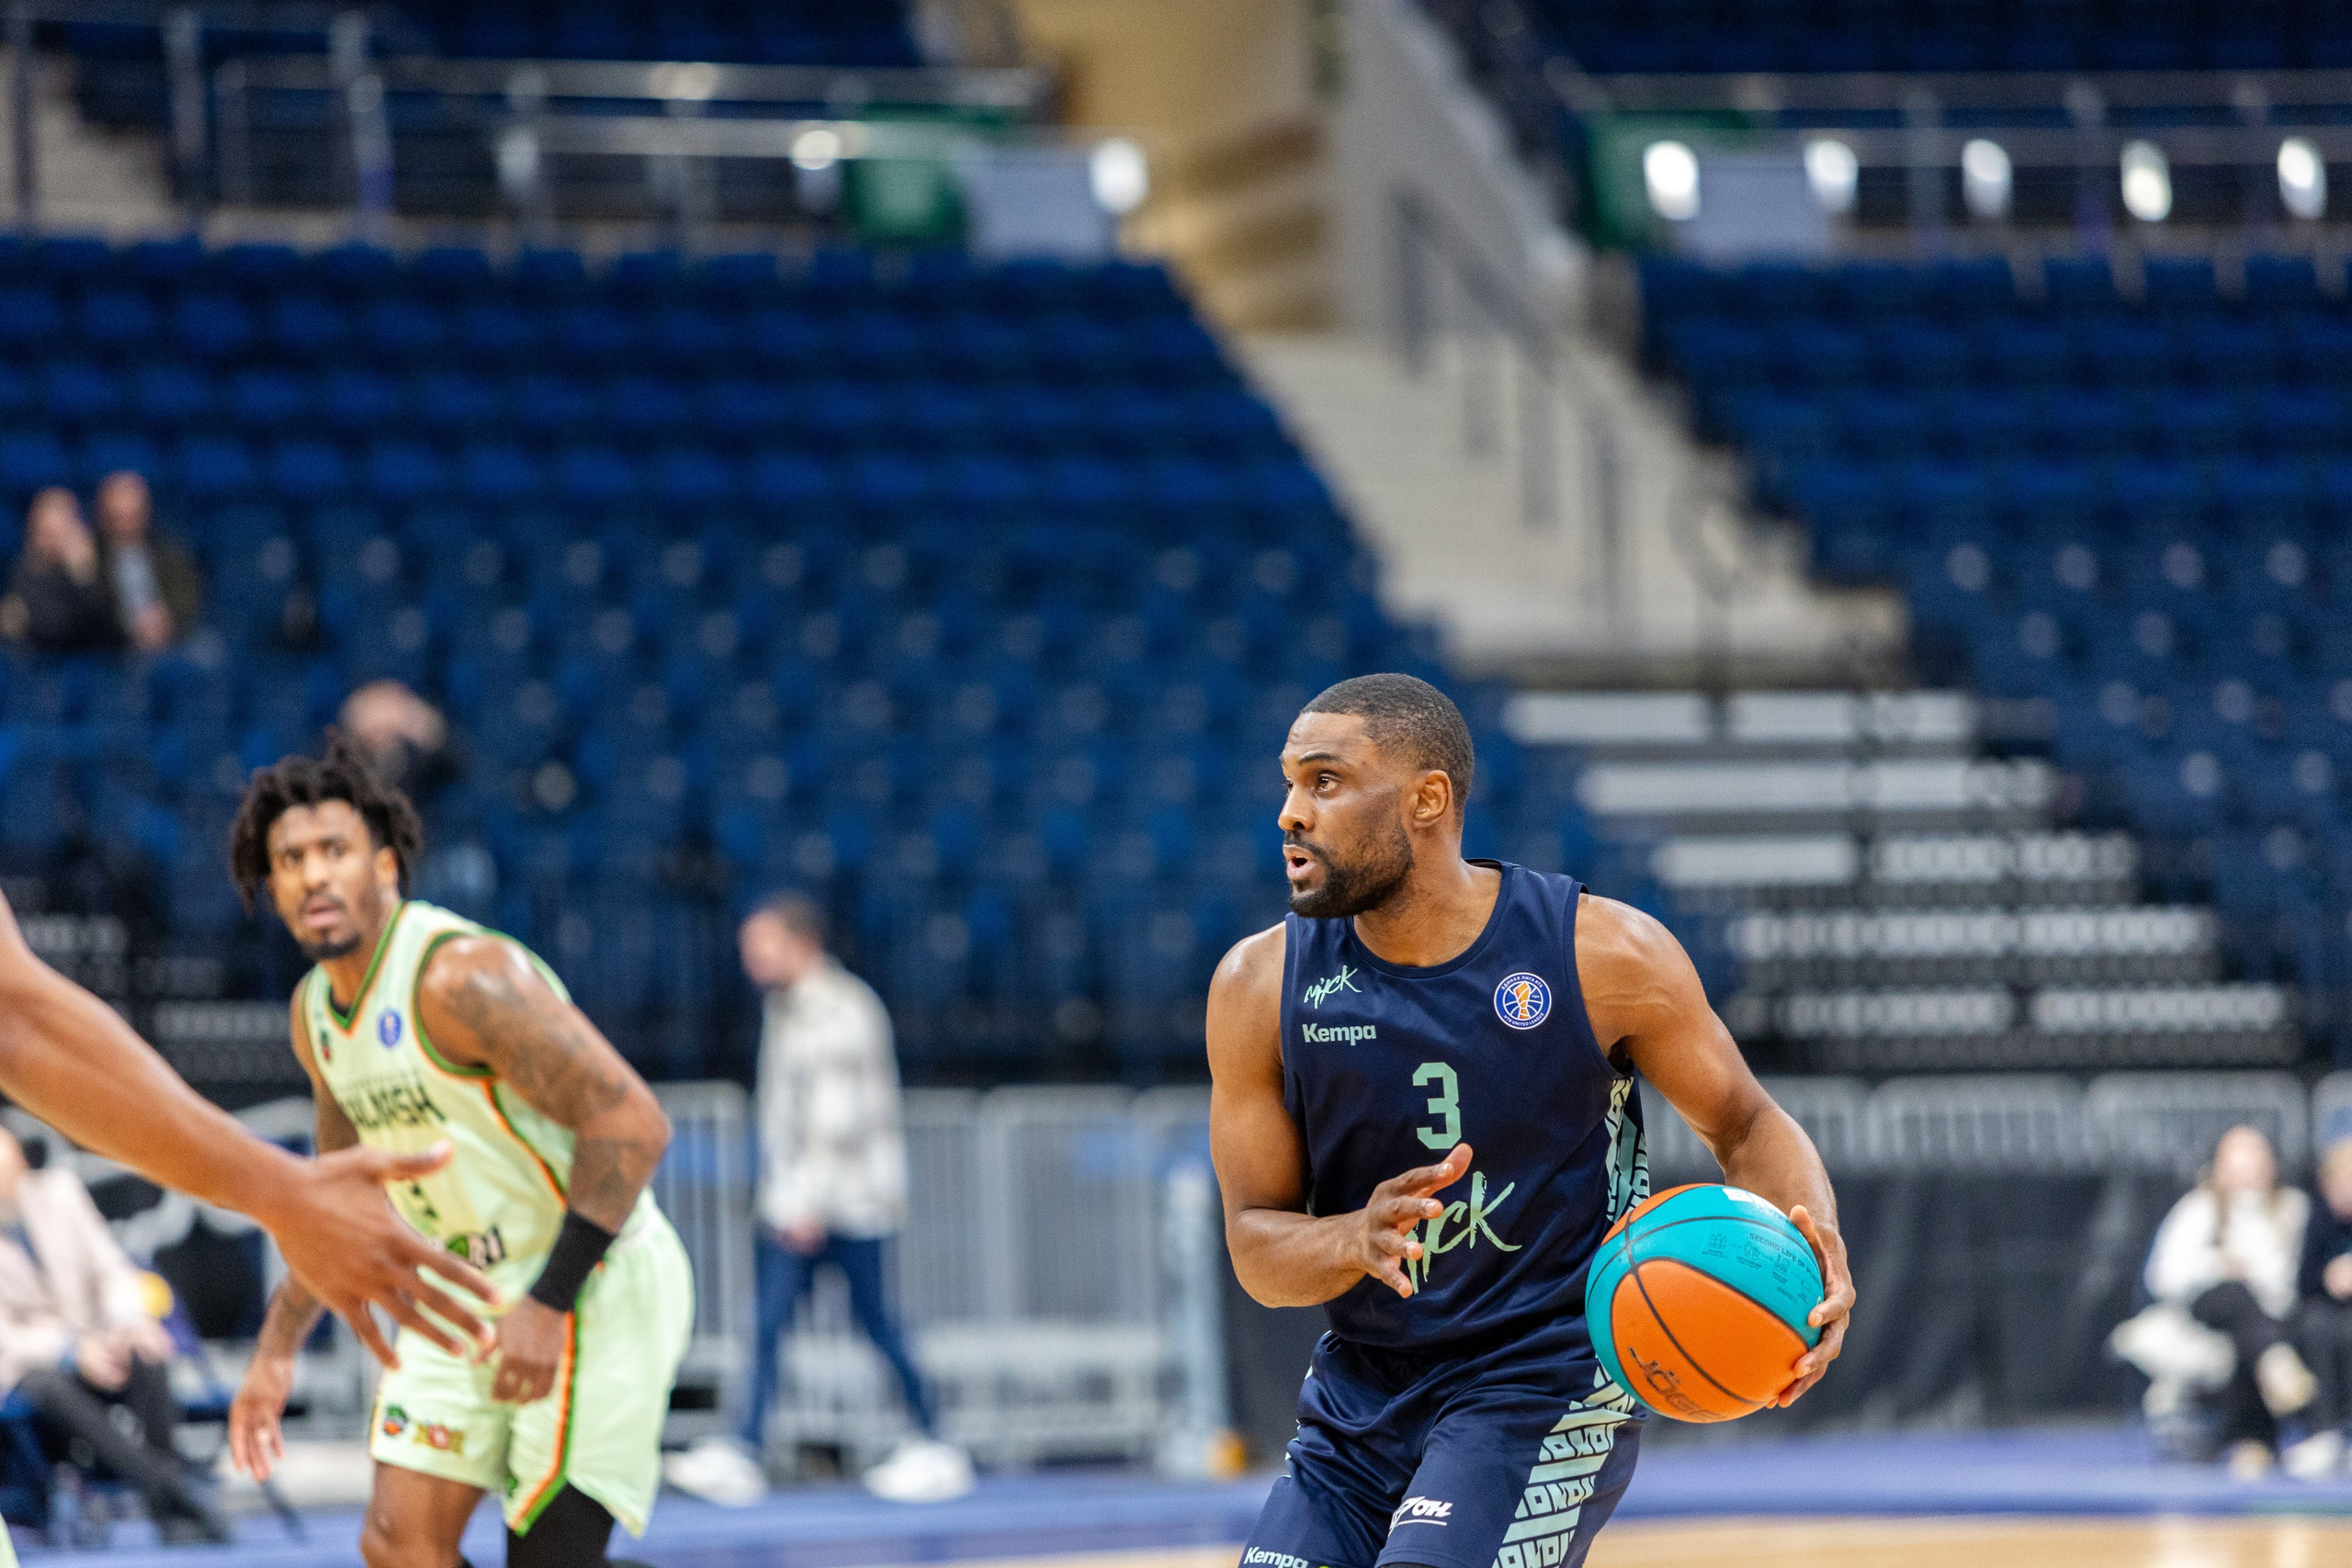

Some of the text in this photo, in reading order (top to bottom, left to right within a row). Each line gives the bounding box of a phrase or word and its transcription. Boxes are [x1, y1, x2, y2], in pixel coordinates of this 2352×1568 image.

[1530, 1012, 1544, 1024] LEAGUE
[1302, 1022, 1377, 1046] Kempa
[1412, 1062, 1462, 1150] 3
[1748, 1232, 1781, 1252] SECOND
[1243, 1546, 1309, 1568] Kempa
